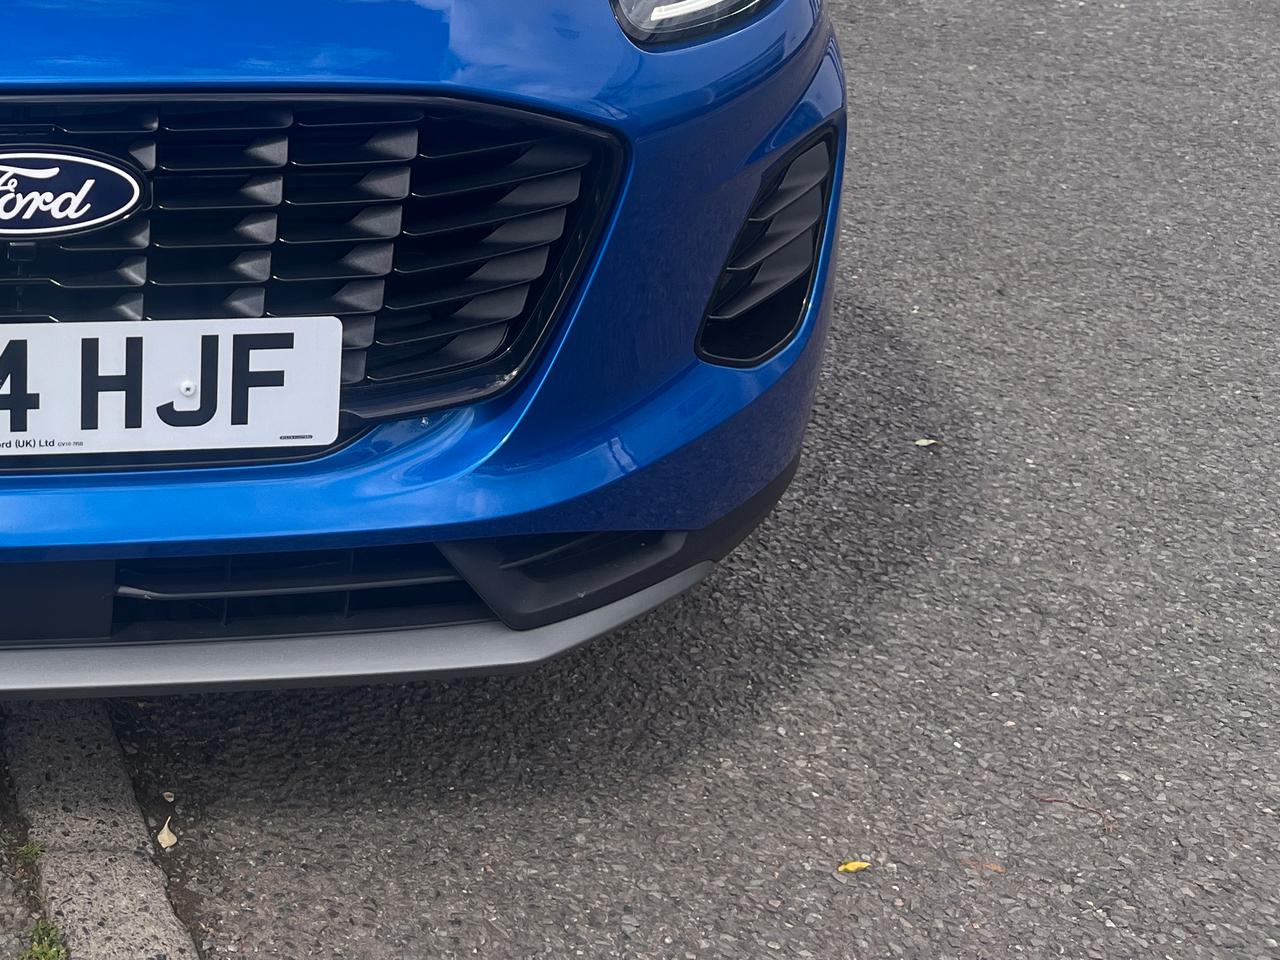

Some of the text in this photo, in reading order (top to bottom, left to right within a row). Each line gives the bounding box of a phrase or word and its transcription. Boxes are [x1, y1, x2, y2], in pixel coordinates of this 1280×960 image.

[81, 332, 295, 431] HJF
[15, 439, 36, 449] (UK)
[39, 439, 55, 448] Ltd
